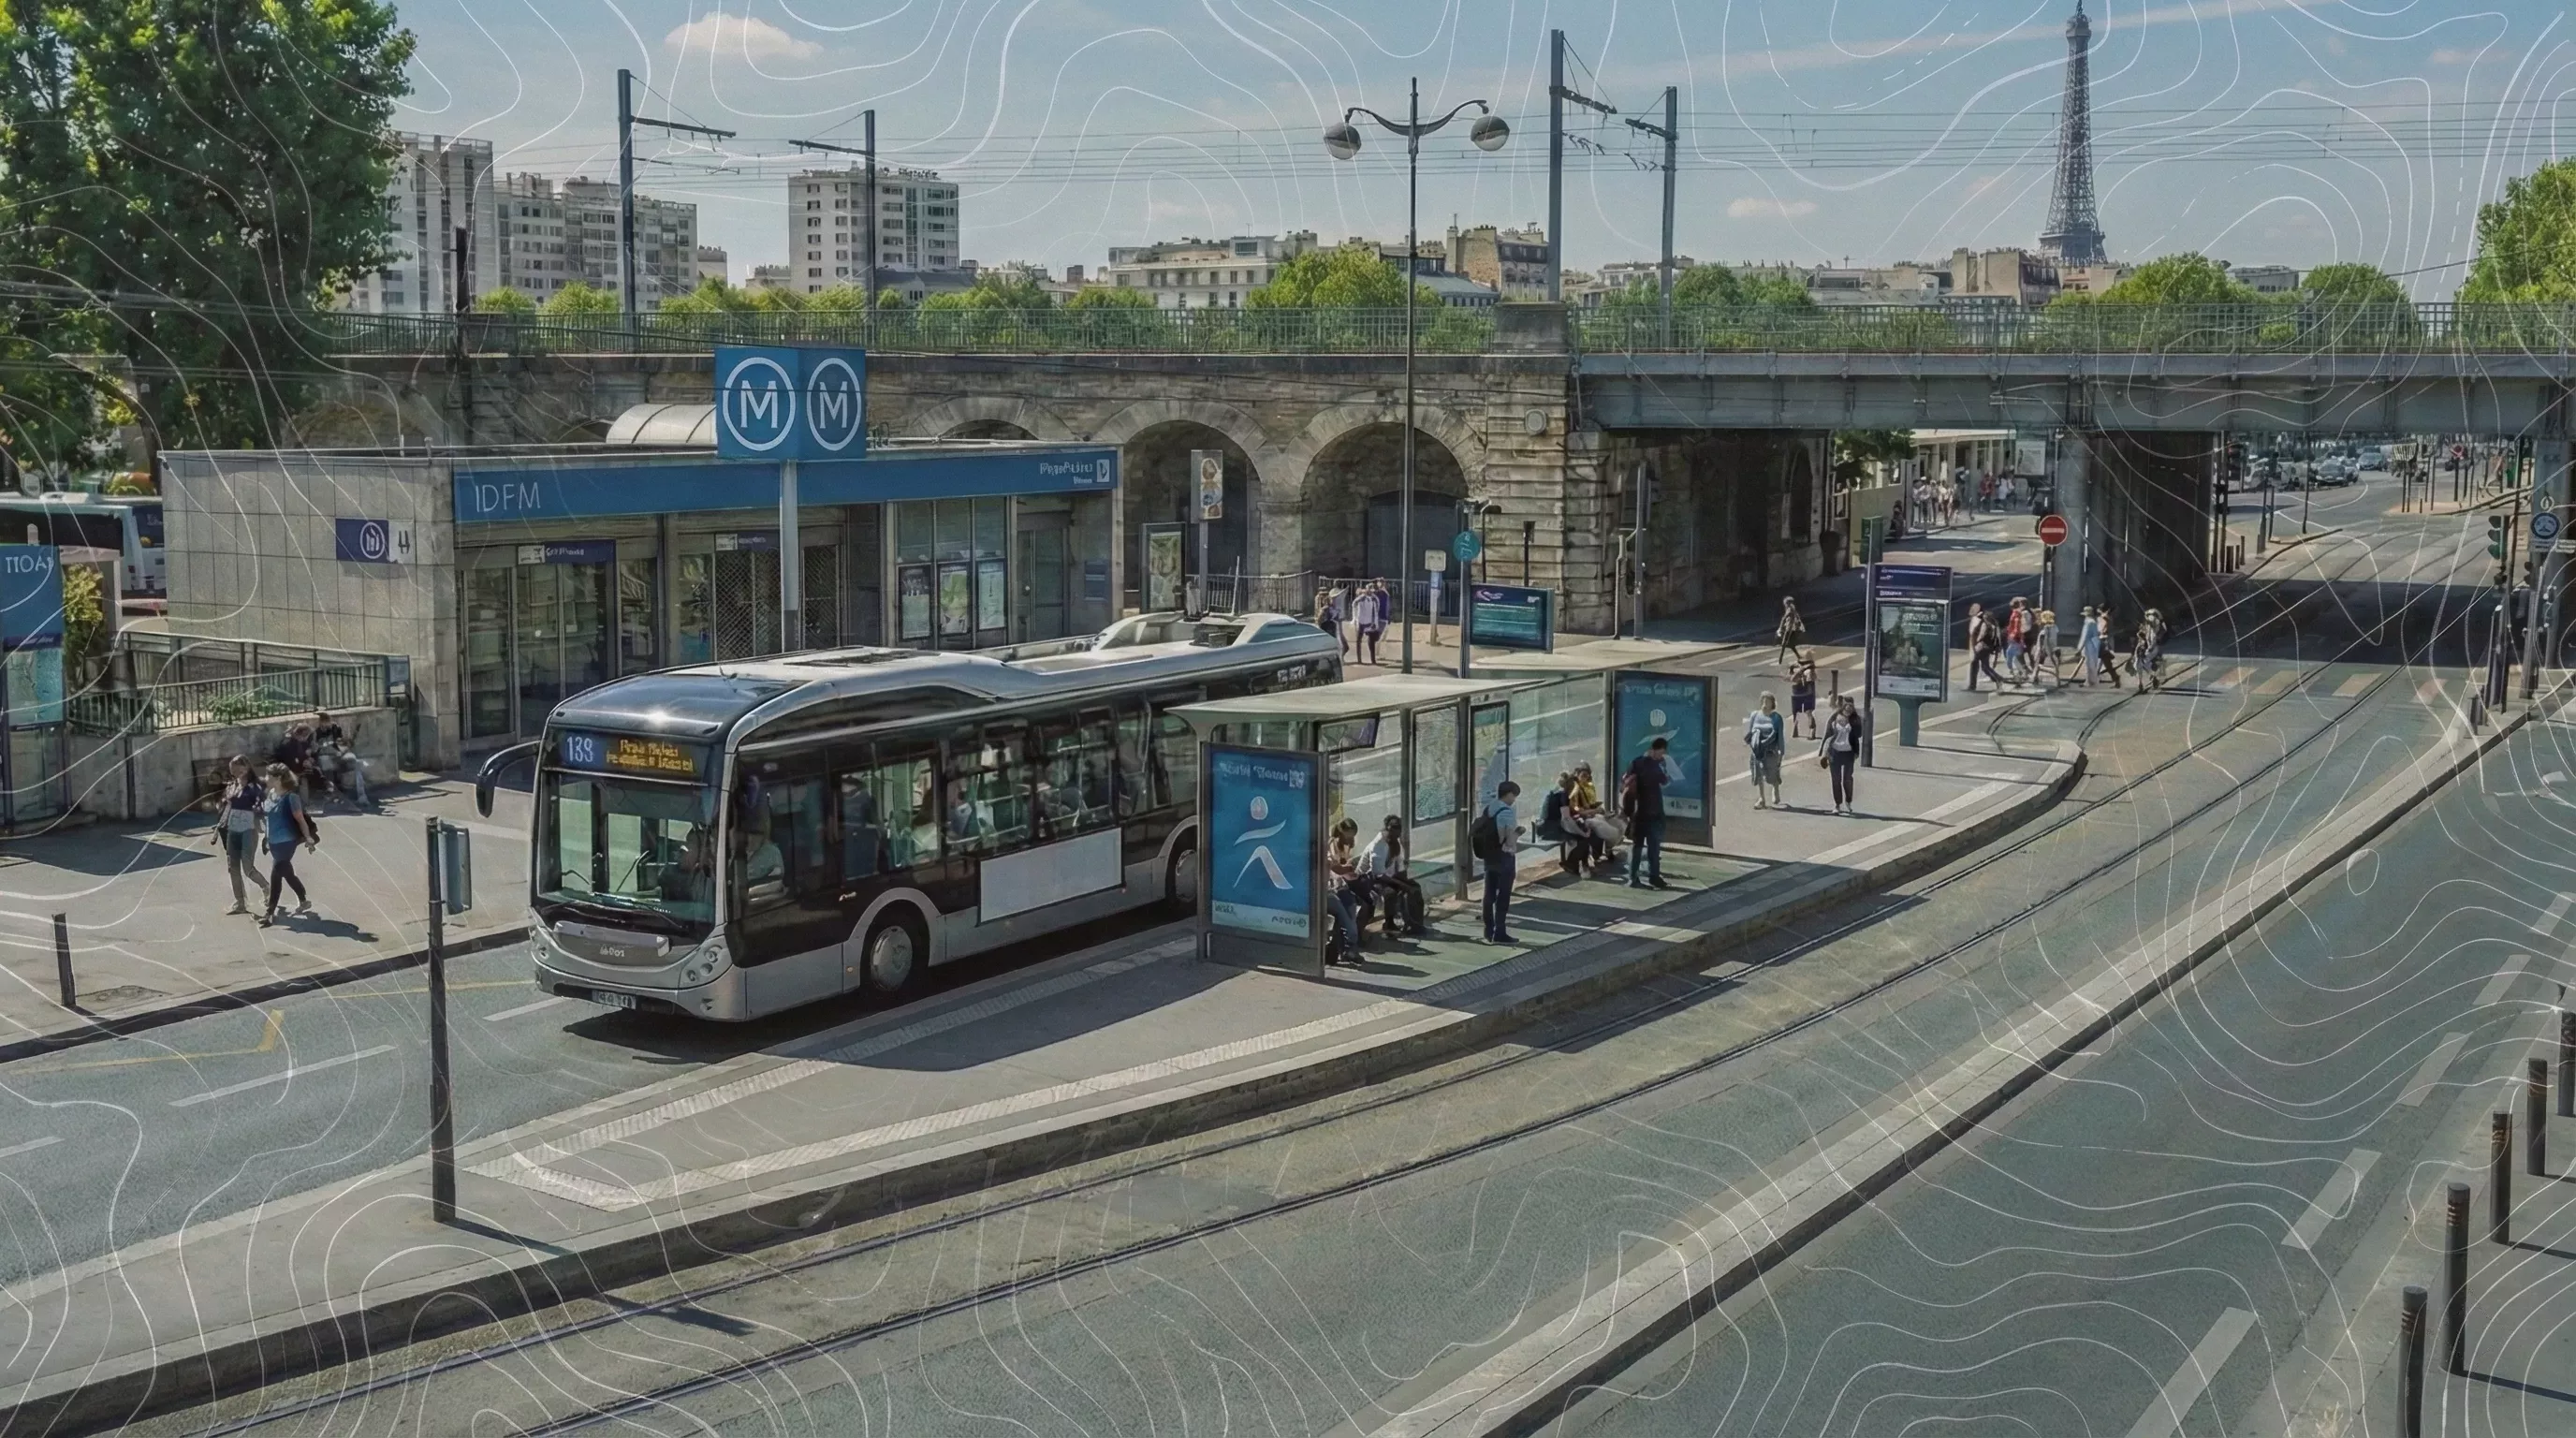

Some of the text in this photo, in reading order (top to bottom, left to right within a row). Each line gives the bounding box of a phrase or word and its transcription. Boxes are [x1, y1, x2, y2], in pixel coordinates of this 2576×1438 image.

[740, 379, 779, 429] M
[819, 381, 848, 429] M
[475, 481, 541, 513] IDFM
